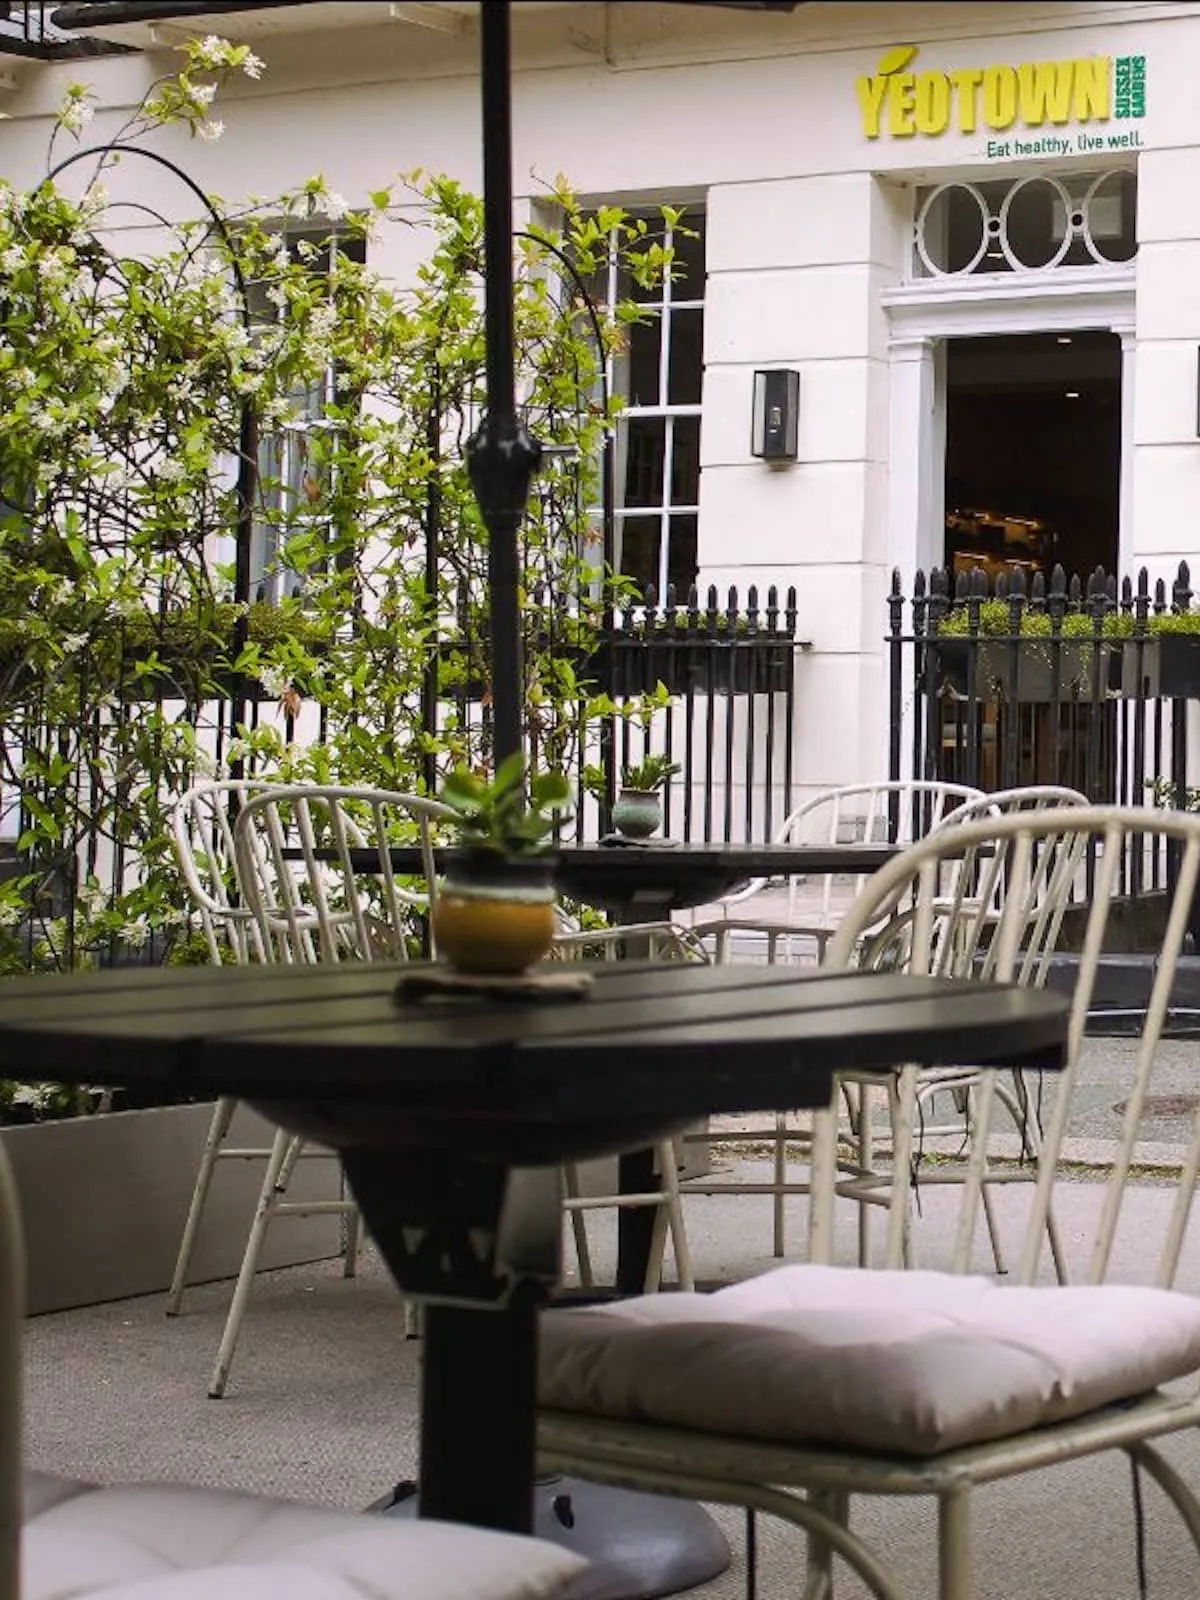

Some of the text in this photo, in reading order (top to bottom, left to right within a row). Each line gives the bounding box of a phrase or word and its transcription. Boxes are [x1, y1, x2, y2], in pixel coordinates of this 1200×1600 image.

[856, 56, 1110, 138] YEOTOWN
[1115, 57, 1131, 119] SUSSEX
[1131, 55, 1146, 118] GARDENS
[987, 131, 1144, 158] Eat healthy, live well.
